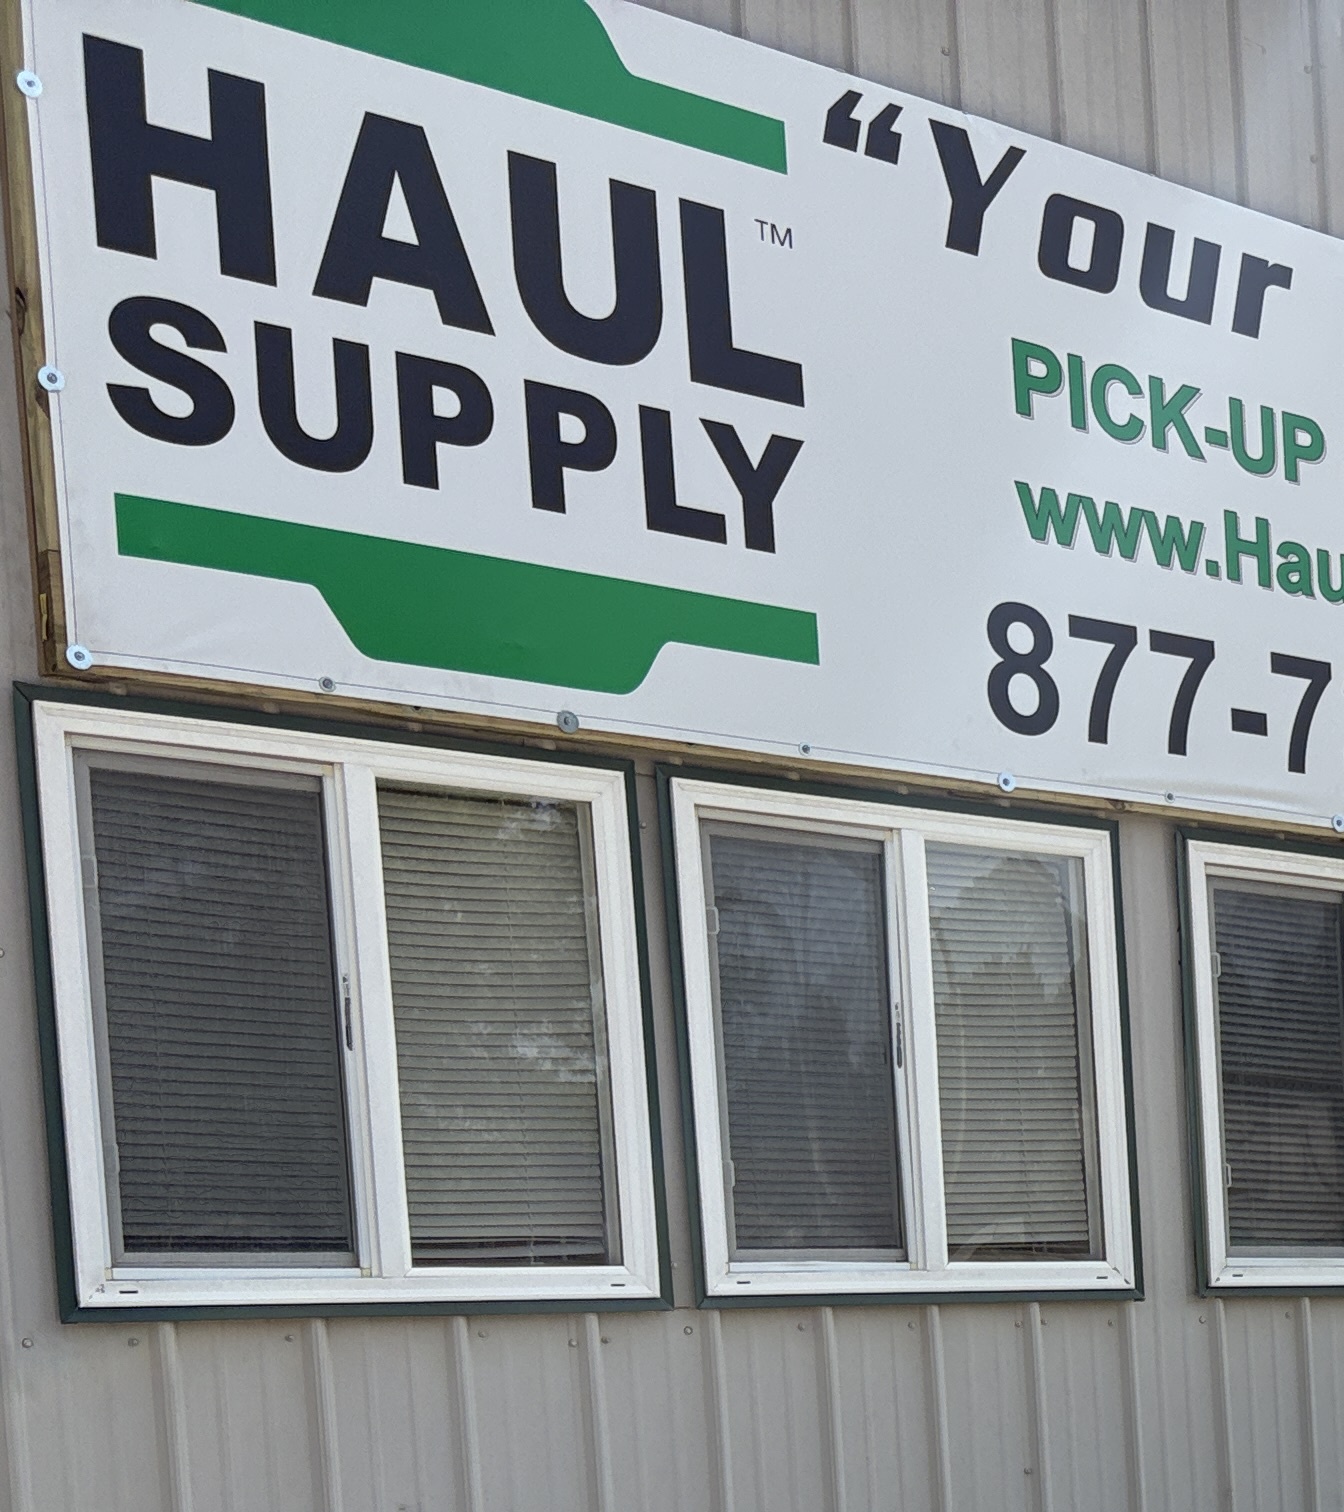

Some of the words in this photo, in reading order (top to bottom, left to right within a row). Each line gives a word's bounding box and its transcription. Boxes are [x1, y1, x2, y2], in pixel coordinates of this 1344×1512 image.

[83, 33, 805, 408] HAUL
[106, 296, 805, 555] SUPPLY
[1011, 337, 1327, 486] PICK-UP
